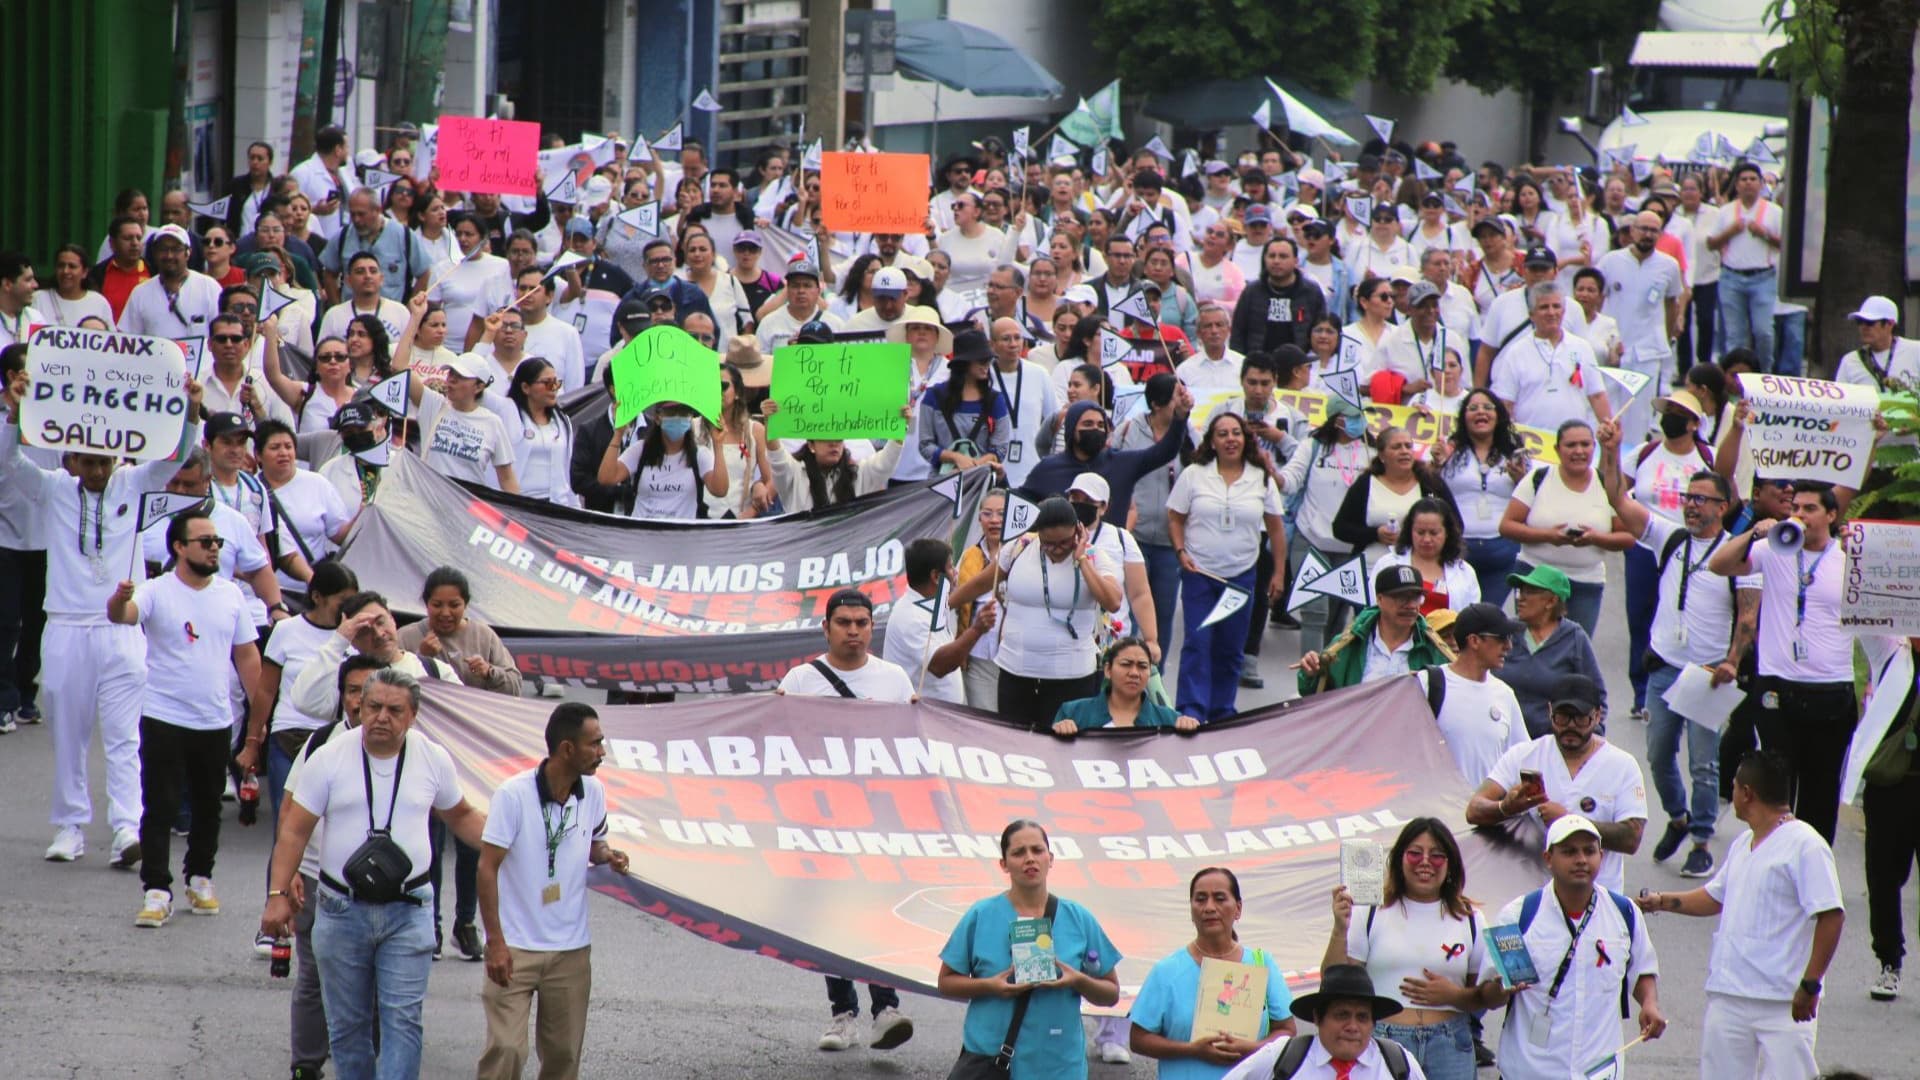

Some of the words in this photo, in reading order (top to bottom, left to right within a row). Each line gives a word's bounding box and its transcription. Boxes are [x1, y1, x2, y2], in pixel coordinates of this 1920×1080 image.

[795, 345, 824, 374] Por
[838, 346, 853, 375] ti
[41, 362, 71, 376] ven
[105, 368, 154, 389] exige
[166, 372, 180, 388] tu
[805, 375, 829, 397] Por
[839, 378, 861, 397] mi
[1760, 375, 1845, 400] SNTSS
[783, 394, 805, 414] Por
[811, 398, 824, 413] el
[80, 412, 107, 425] en
[1753, 411, 1831, 432] JUNTOS
[41, 420, 146, 453] SALUD
[1793, 430, 1857, 449] NUESTRO
[1011, 521, 1027, 529] IMSS
[468, 525, 535, 570] POR
[540, 561, 588, 594] UN
[797, 538, 904, 589] BAJO
[1340, 587, 1359, 595] IMSS
[603, 735, 1054, 788] RABAJAMOS
[1071, 748, 1268, 789] BAJO
[597, 768, 1310, 834] PROTESTA
[659, 819, 755, 849] UN
[777, 827, 1084, 860] AUMENO
[1100, 809, 1415, 861] SALARIAL
